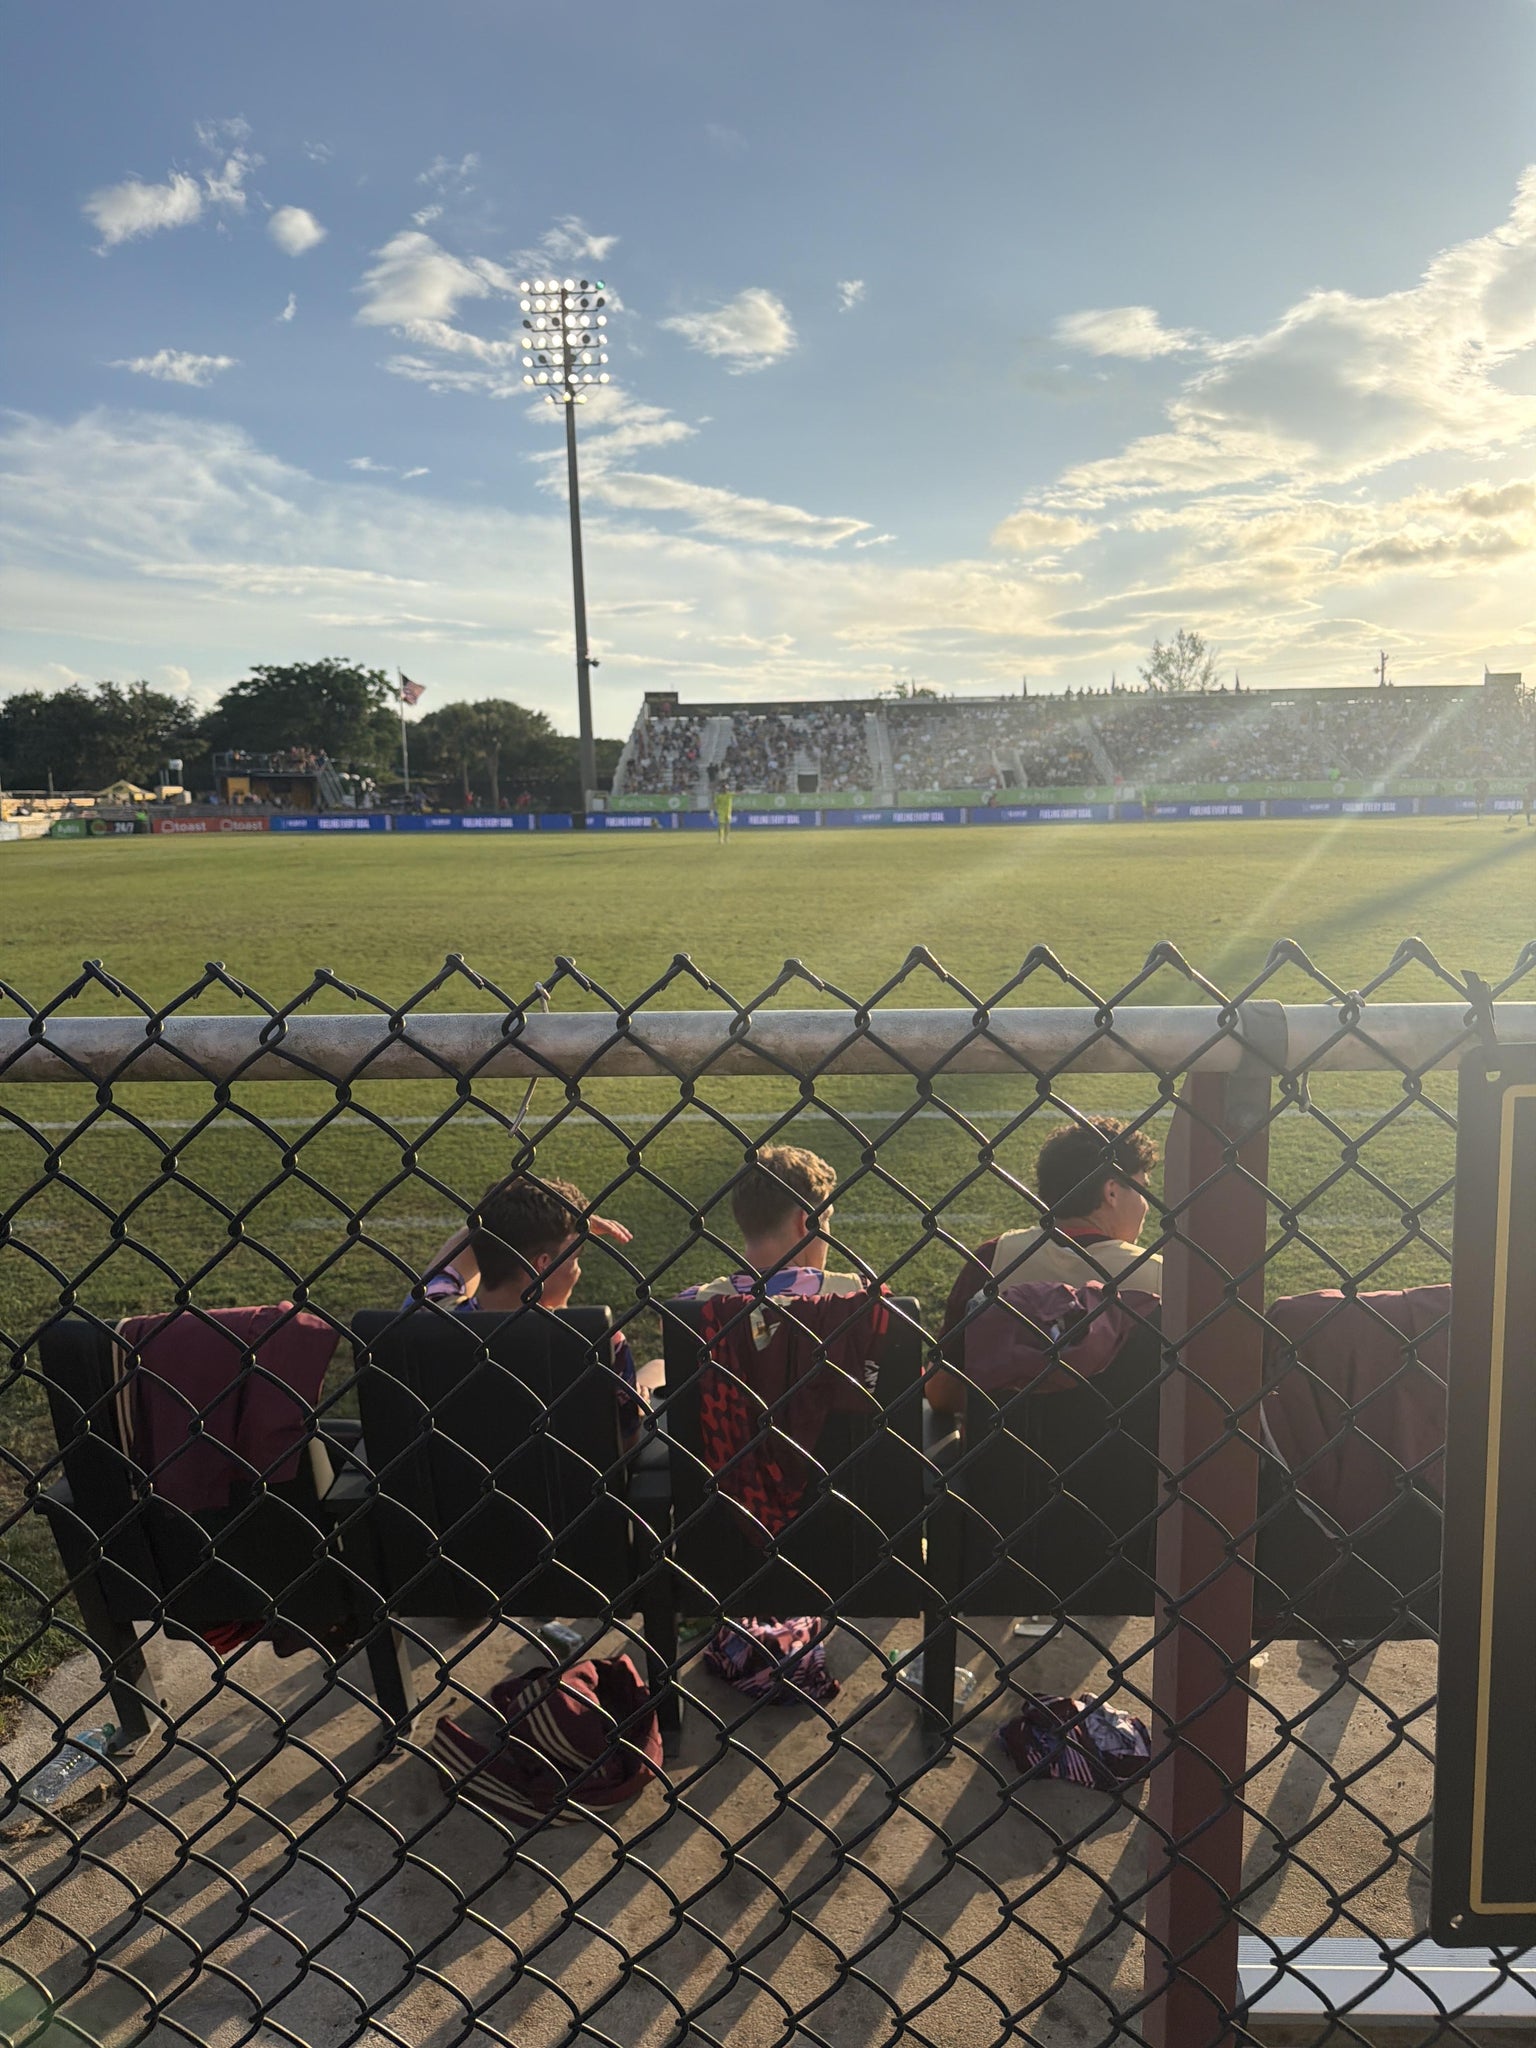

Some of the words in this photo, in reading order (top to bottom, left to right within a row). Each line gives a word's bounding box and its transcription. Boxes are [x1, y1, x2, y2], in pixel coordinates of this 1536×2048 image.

[114, 821, 134, 833] 24/7
[174, 822, 207, 832] toast
[232, 820, 263, 831] toast
